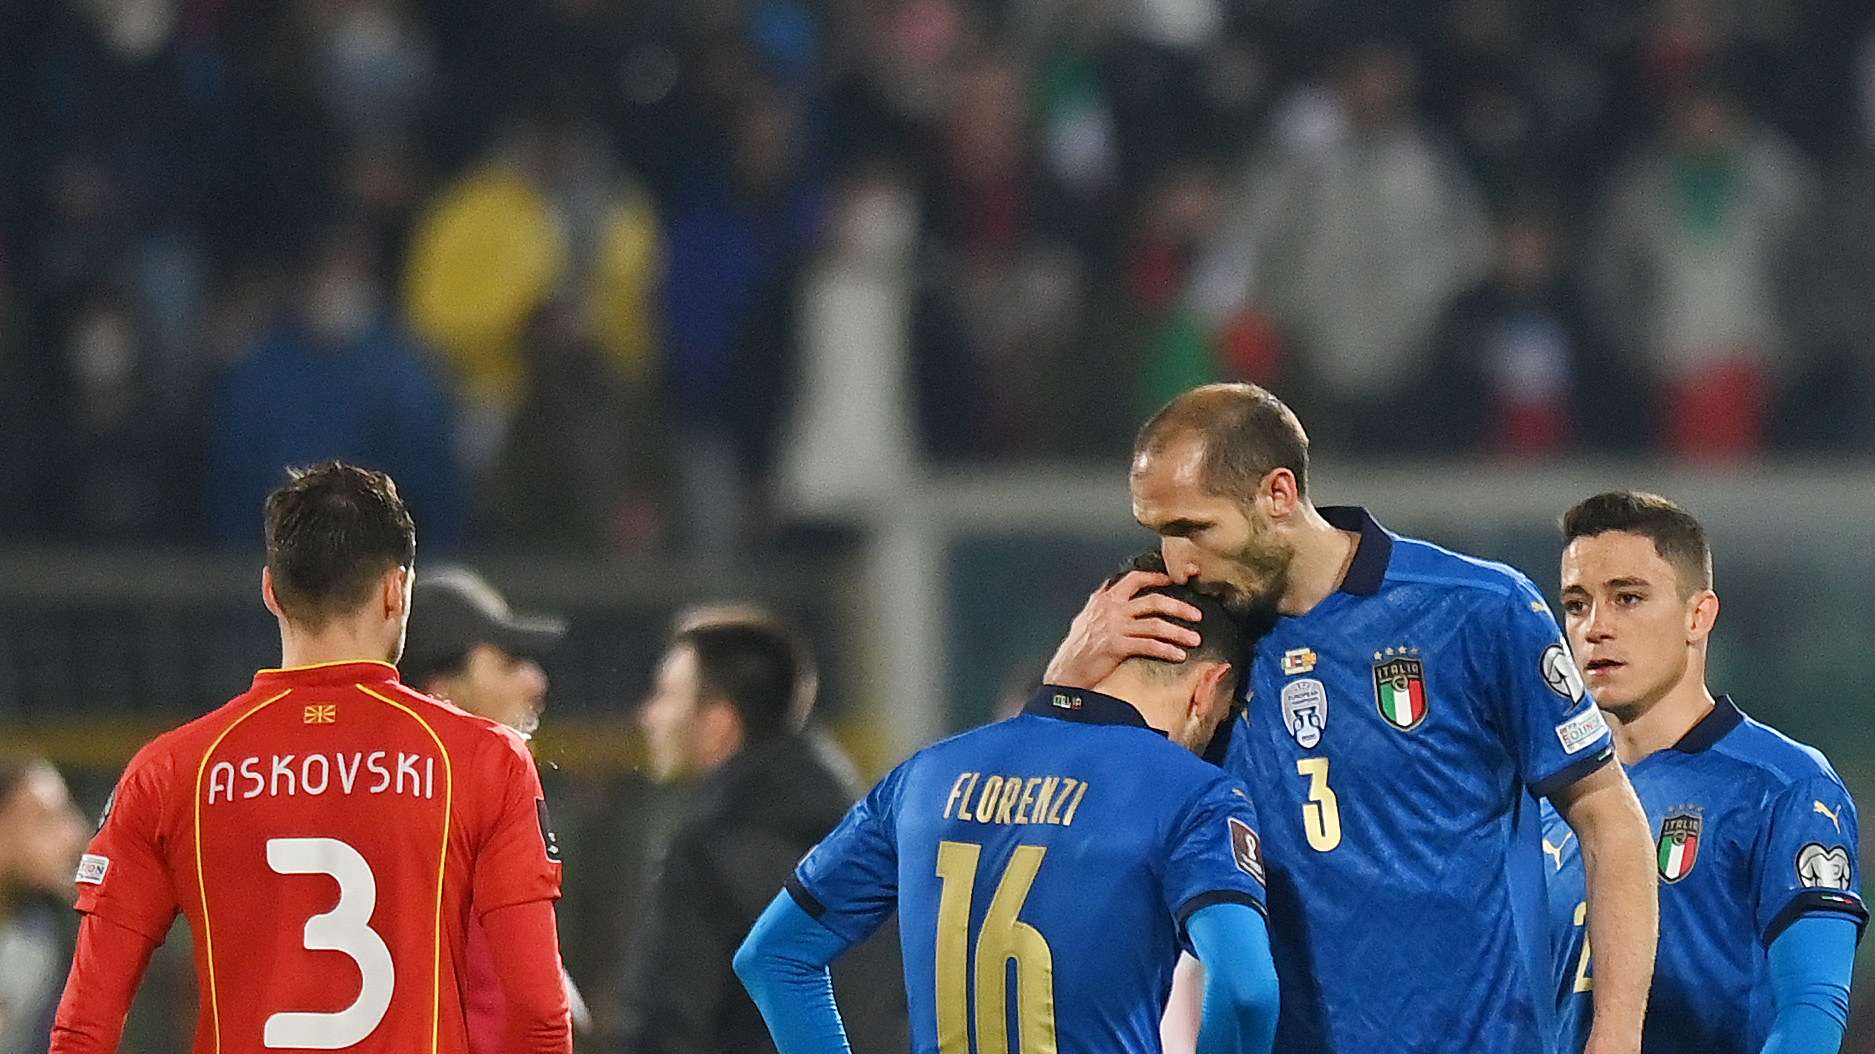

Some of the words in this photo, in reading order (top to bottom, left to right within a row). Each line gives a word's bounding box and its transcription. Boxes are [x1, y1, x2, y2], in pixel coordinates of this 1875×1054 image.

[1377, 663, 1419, 680] ITALIA
[208, 751, 433, 804] ASKOVSKI
[944, 771, 1089, 826] FLORENZI
[1296, 757, 1342, 852] 3
[1664, 818, 1700, 832] ITALIA
[264, 837, 395, 1049] 3
